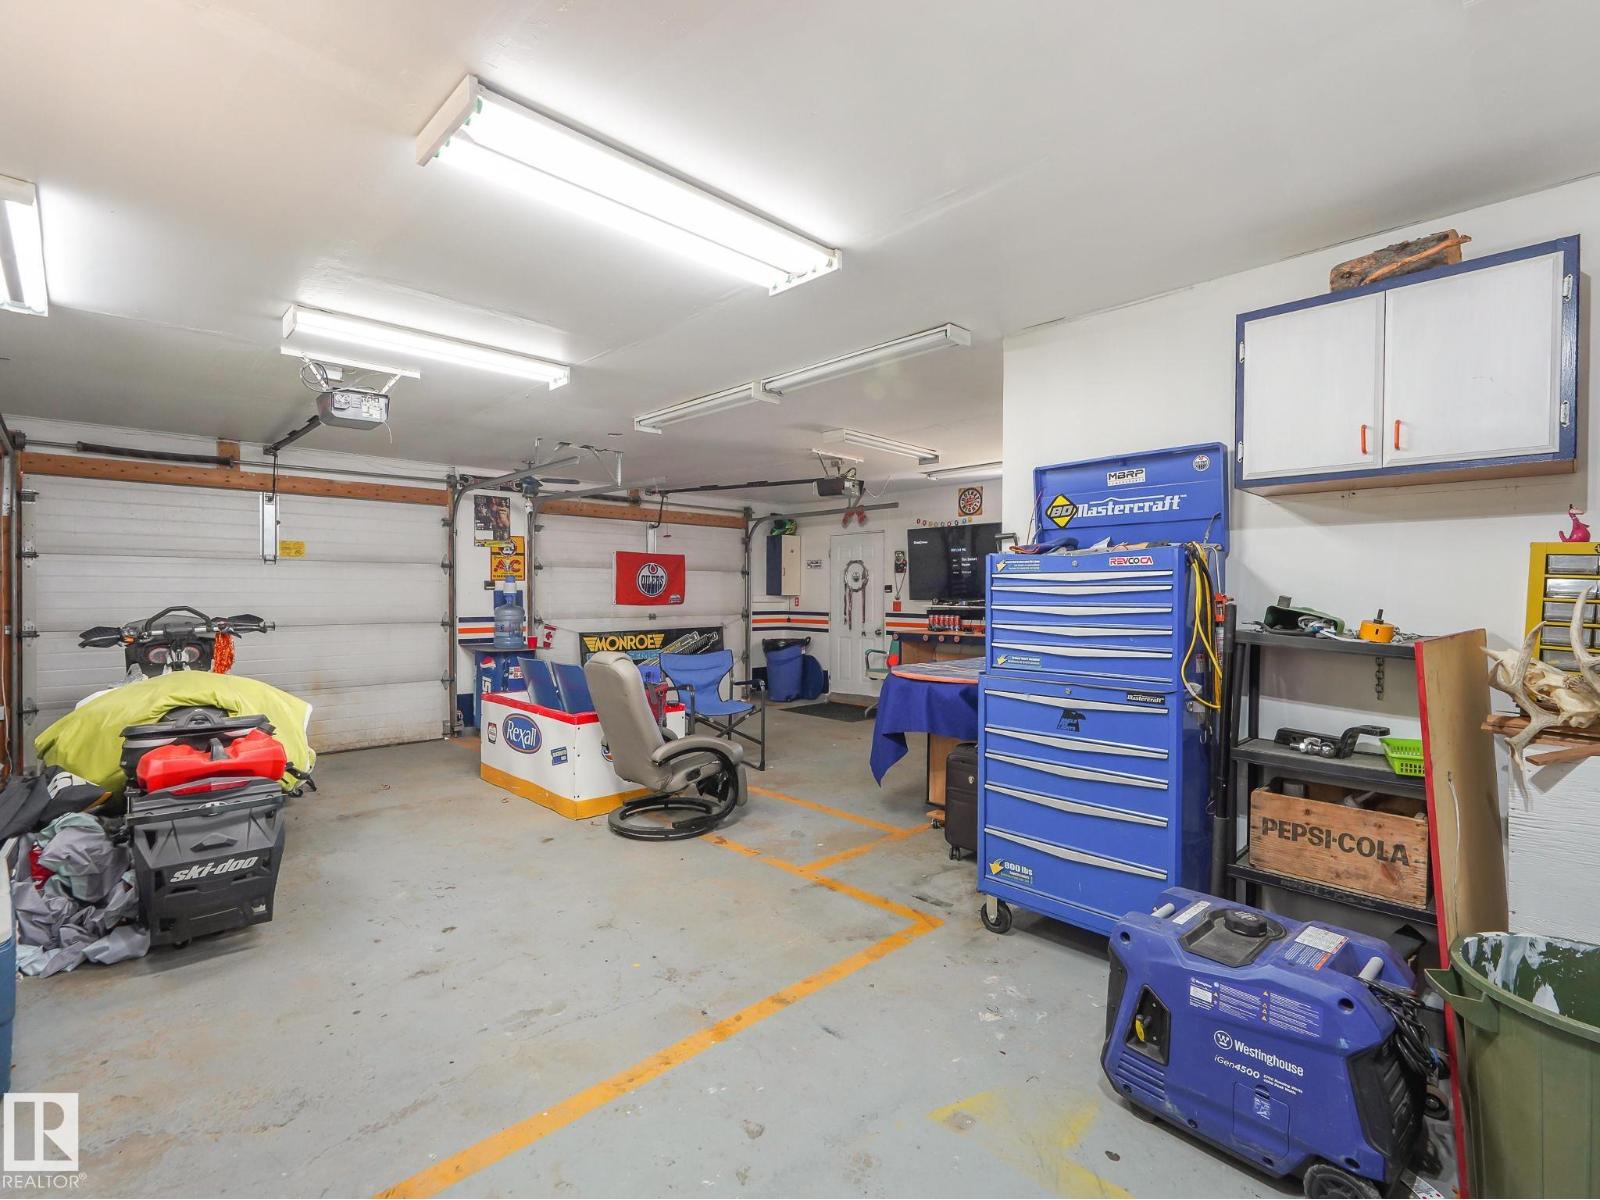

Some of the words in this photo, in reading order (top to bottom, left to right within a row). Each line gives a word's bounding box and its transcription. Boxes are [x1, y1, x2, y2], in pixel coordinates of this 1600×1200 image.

[1108, 469, 1144, 481] MBRP
[640, 574, 664, 596] OILERS
[595, 634, 656, 651] MONROE
[506, 720, 537, 749] Rexall
[1262, 816, 1410, 866] PEPSI-COLA
[1214, 1054, 1260, 1079] iGen4500
[1234, 1040, 1304, 1077] Westinghouse
